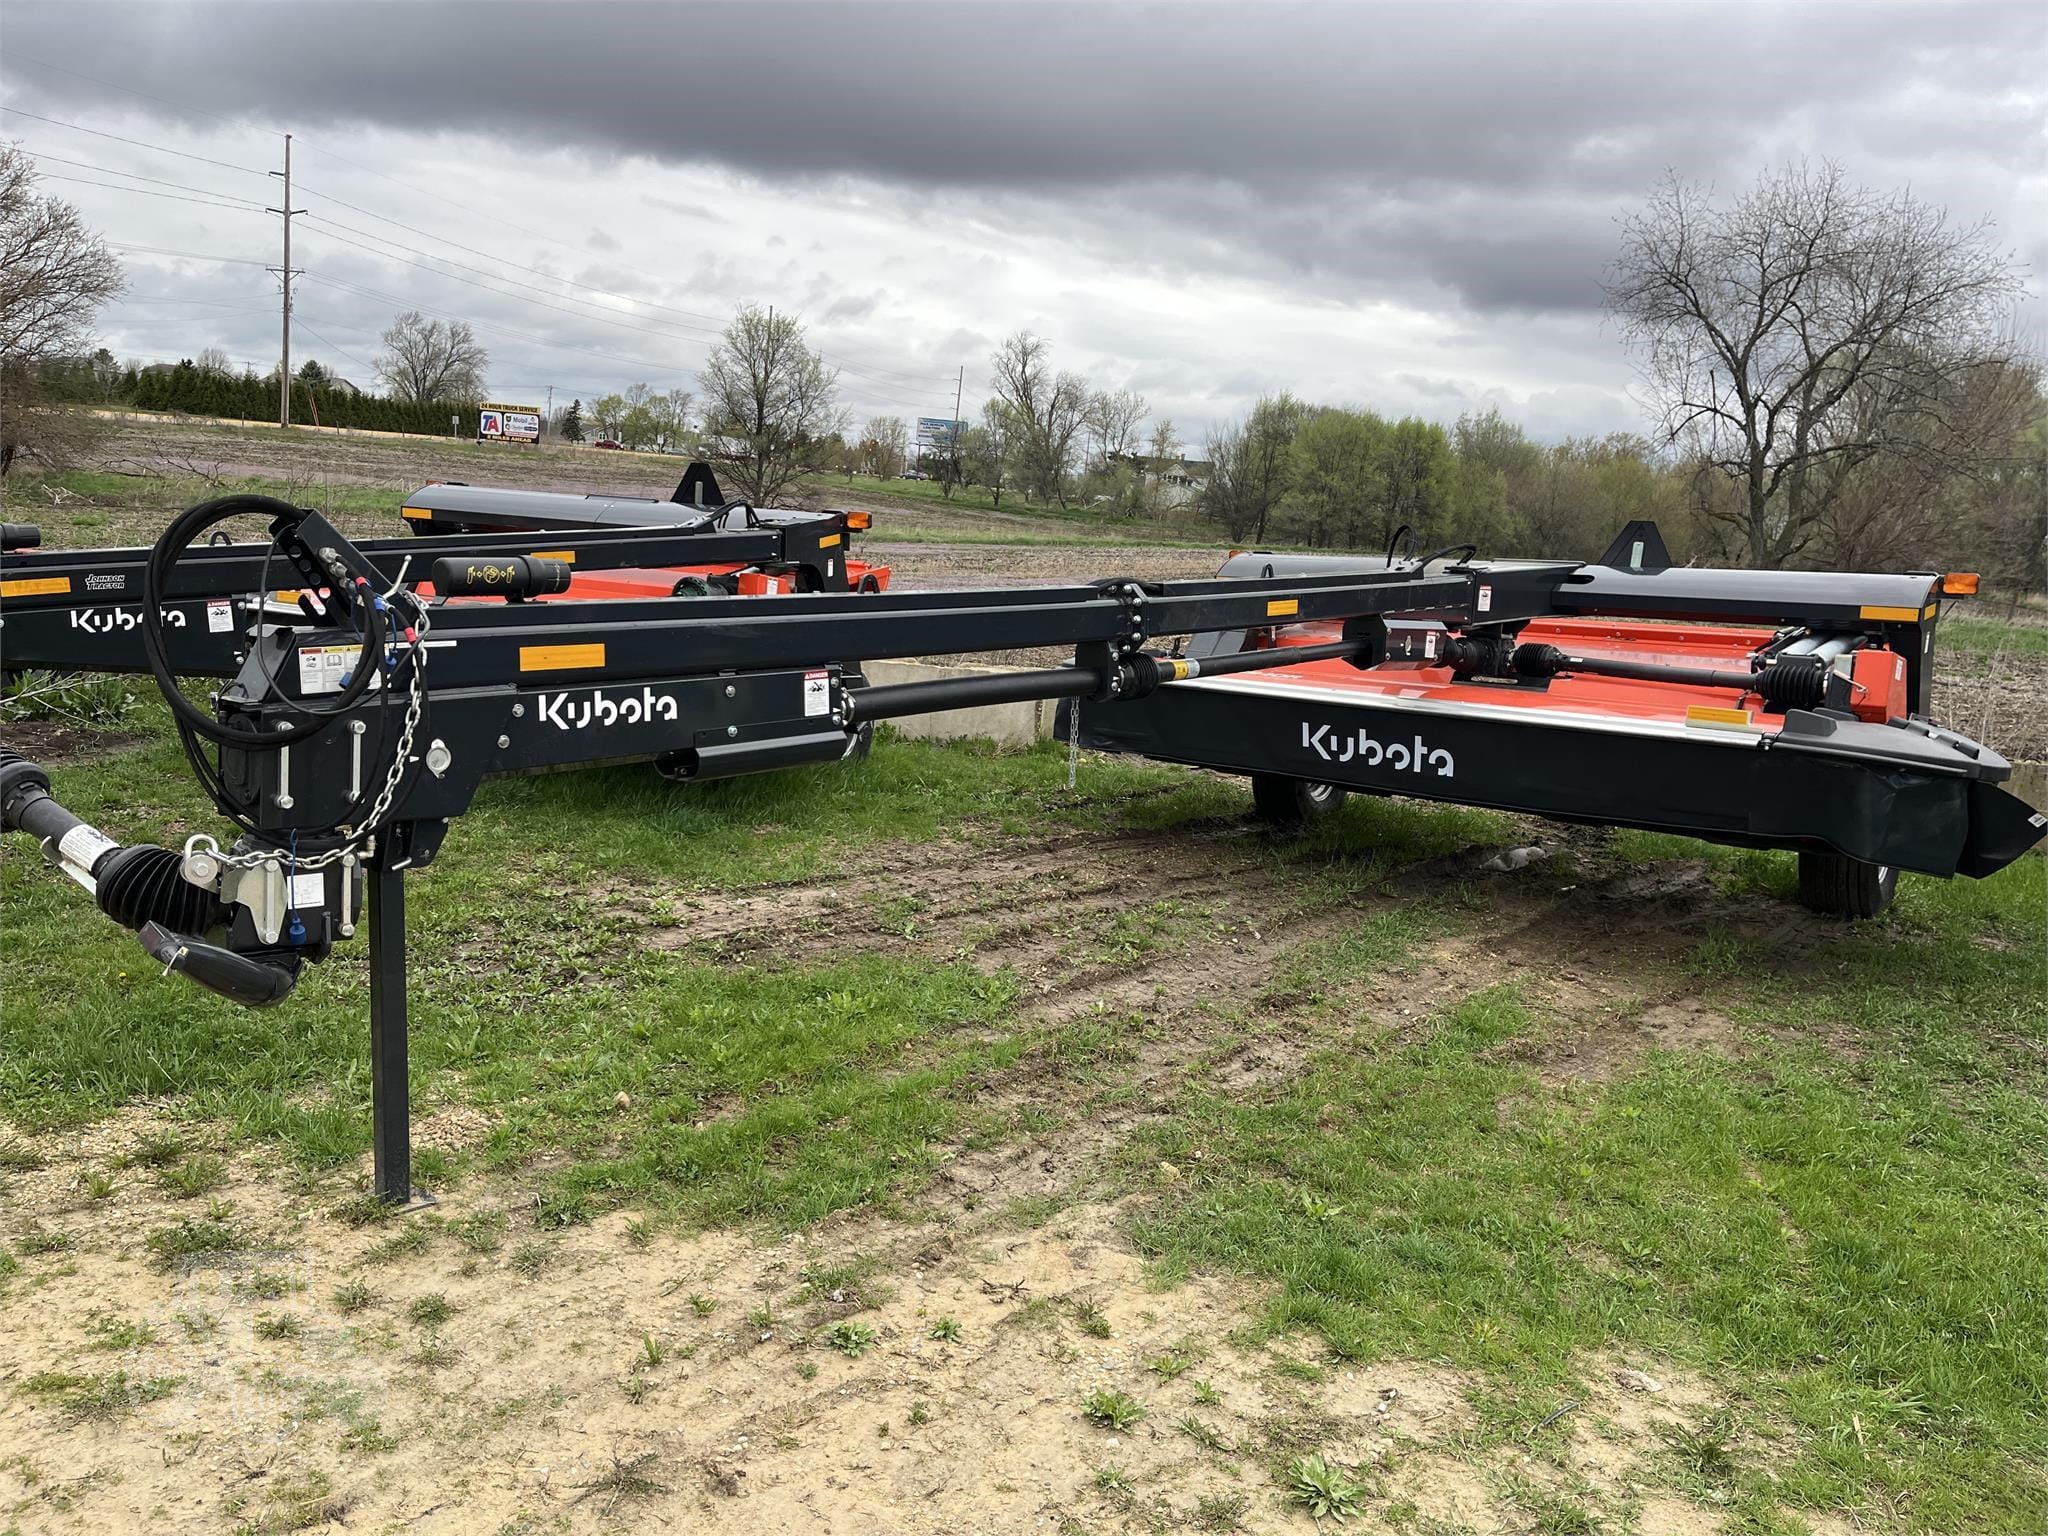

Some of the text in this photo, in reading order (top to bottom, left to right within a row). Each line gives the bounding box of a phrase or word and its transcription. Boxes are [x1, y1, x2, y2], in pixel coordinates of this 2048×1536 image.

[483, 415, 499, 432] TA
[85, 574, 125, 583] JOHNSON
[86, 582, 125, 590] TRACTOR
[538, 687, 678, 730] Kubota
[1302, 722, 1454, 777] Kubota
